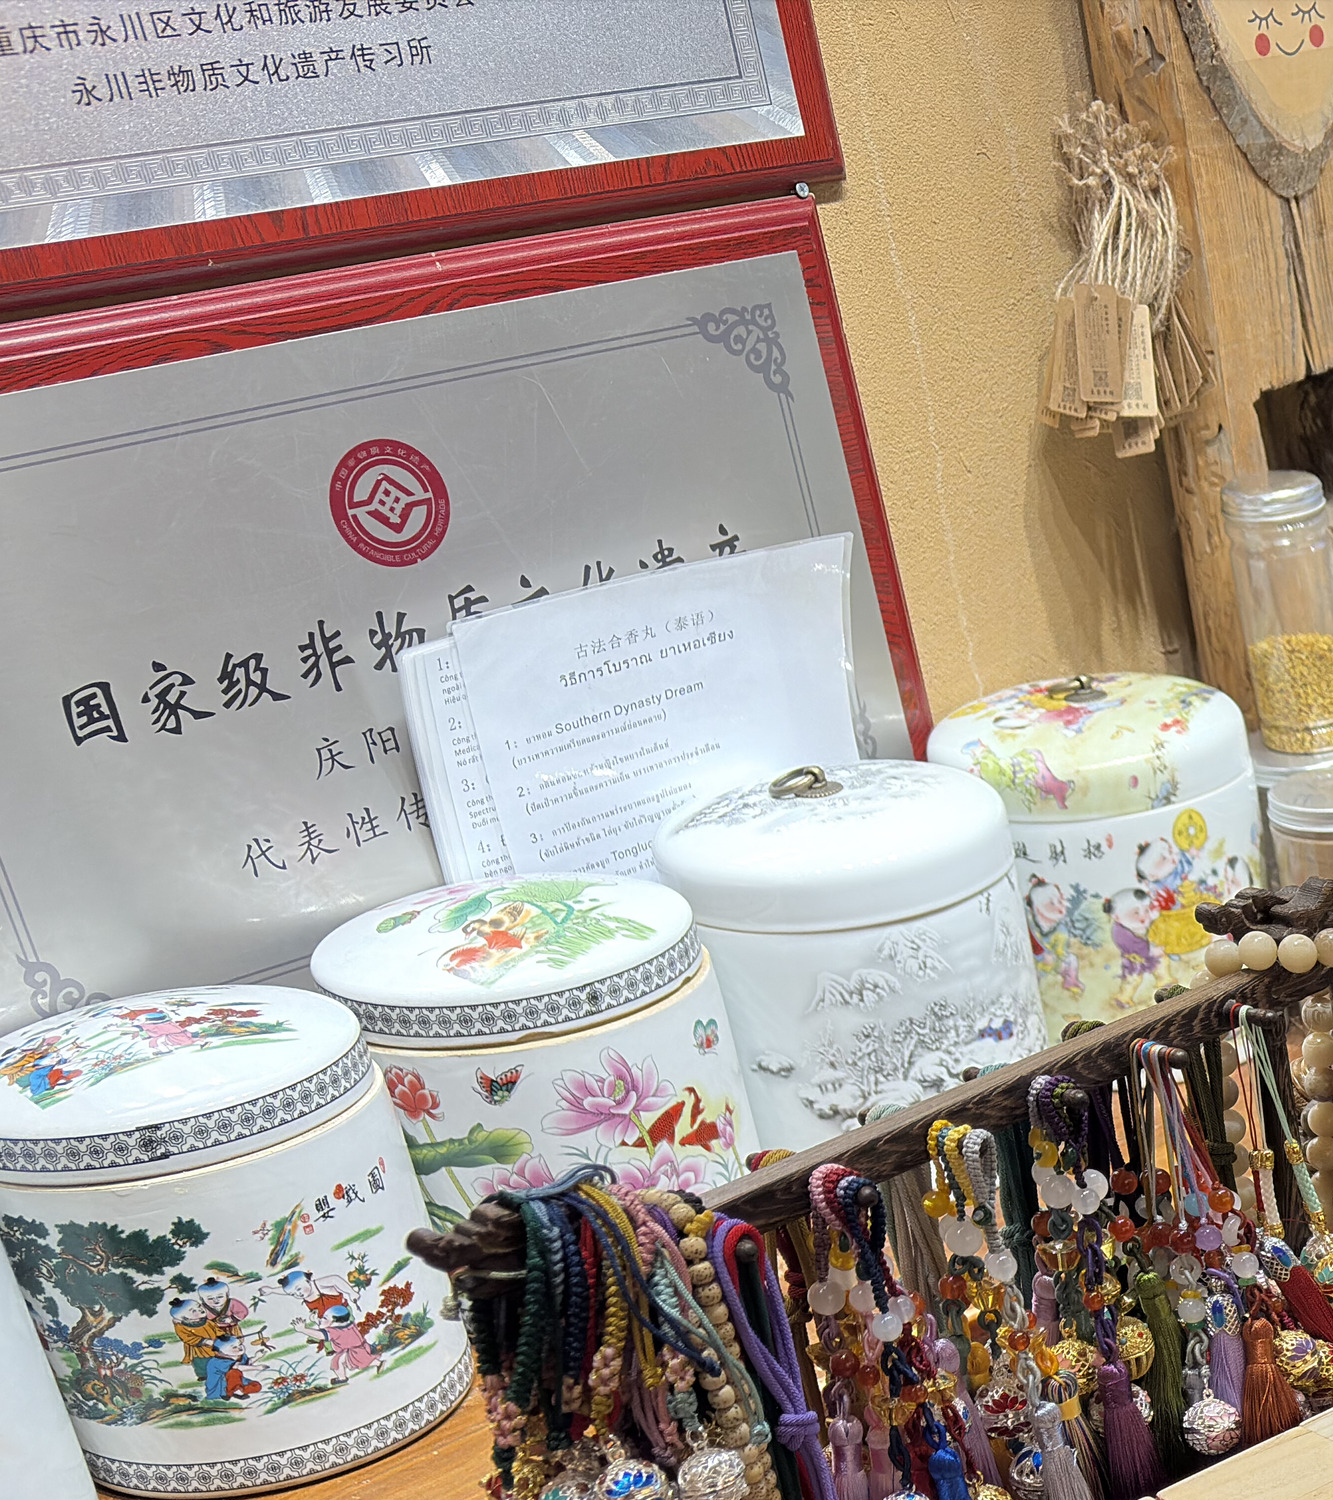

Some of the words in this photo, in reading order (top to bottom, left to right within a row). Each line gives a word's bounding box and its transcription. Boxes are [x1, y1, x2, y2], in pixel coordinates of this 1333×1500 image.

[0, 0, 476, 57] 重庆市永川区文化和旅游发展委
[71, 36, 434, 107] 永川非物质文化遗产传习所
[340, 519, 358, 543] CHINA
[358, 543, 401, 562] INTANGIBLE
[403, 539, 437, 561] CULTURAL
[433, 498, 446, 537] HERITAGE
[573, 609, 717, 660] 古法合香丸（泰语）
[555, 710, 612, 735] Southern
[613, 693, 662, 718] Dynasty
[664, 680, 705, 700] Dream
[314, 725, 400, 781] 庆阳
[240, 792, 430, 881] 代表性传
